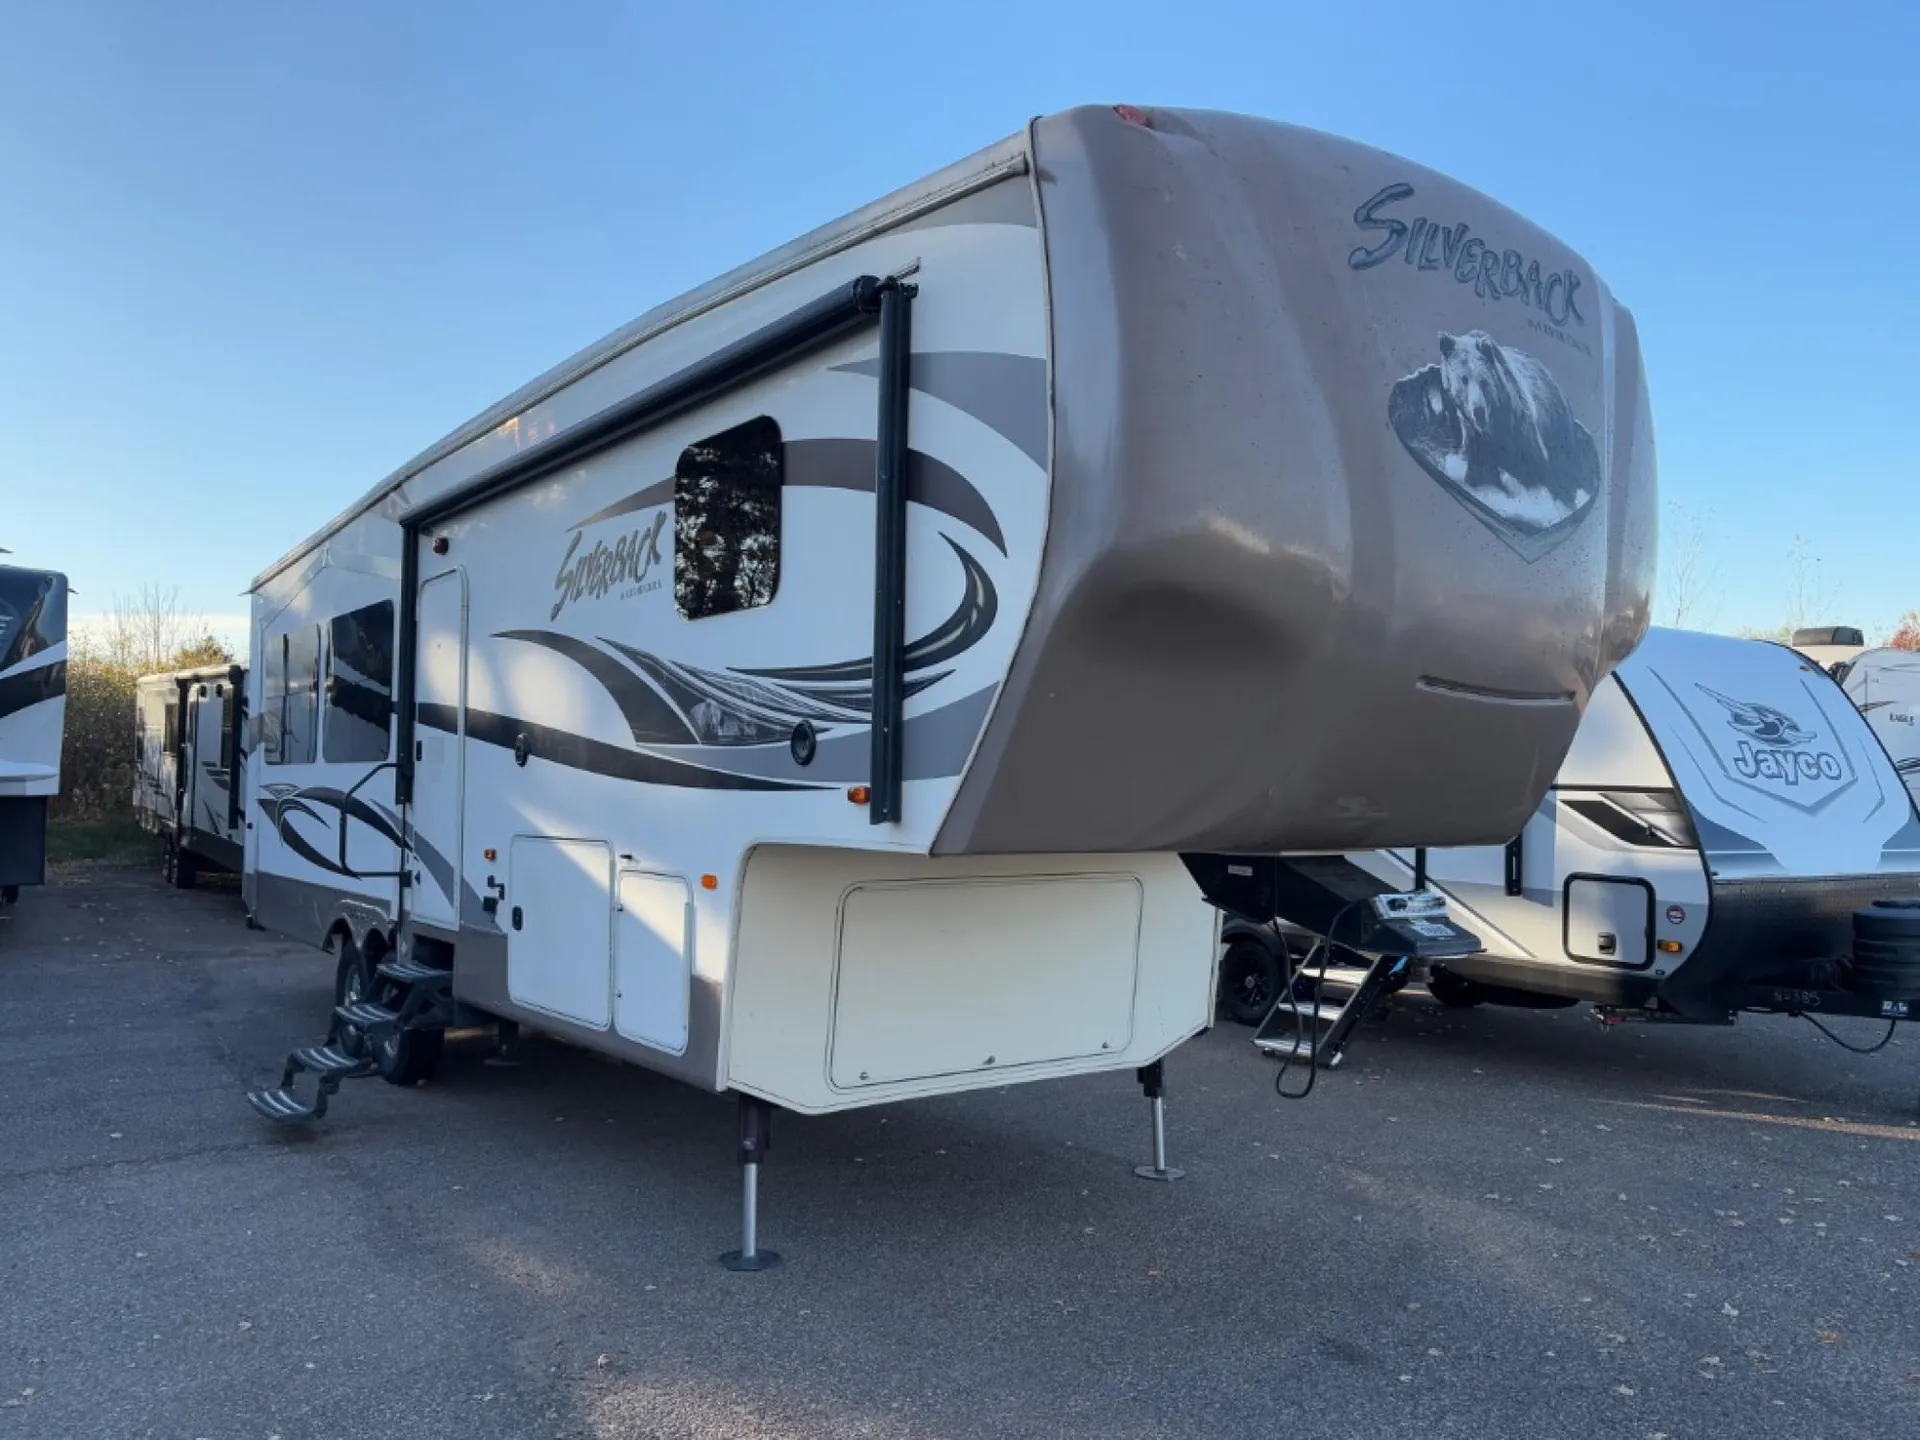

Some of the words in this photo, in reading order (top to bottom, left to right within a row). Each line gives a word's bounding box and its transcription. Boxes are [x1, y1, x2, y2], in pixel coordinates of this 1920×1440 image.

[1348, 183, 1584, 327] SILVERBACK
[551, 510, 667, 622] SILVERBACK
[1889, 712, 1916, 724] EAGLE
[1733, 740, 1842, 786] Jayco
